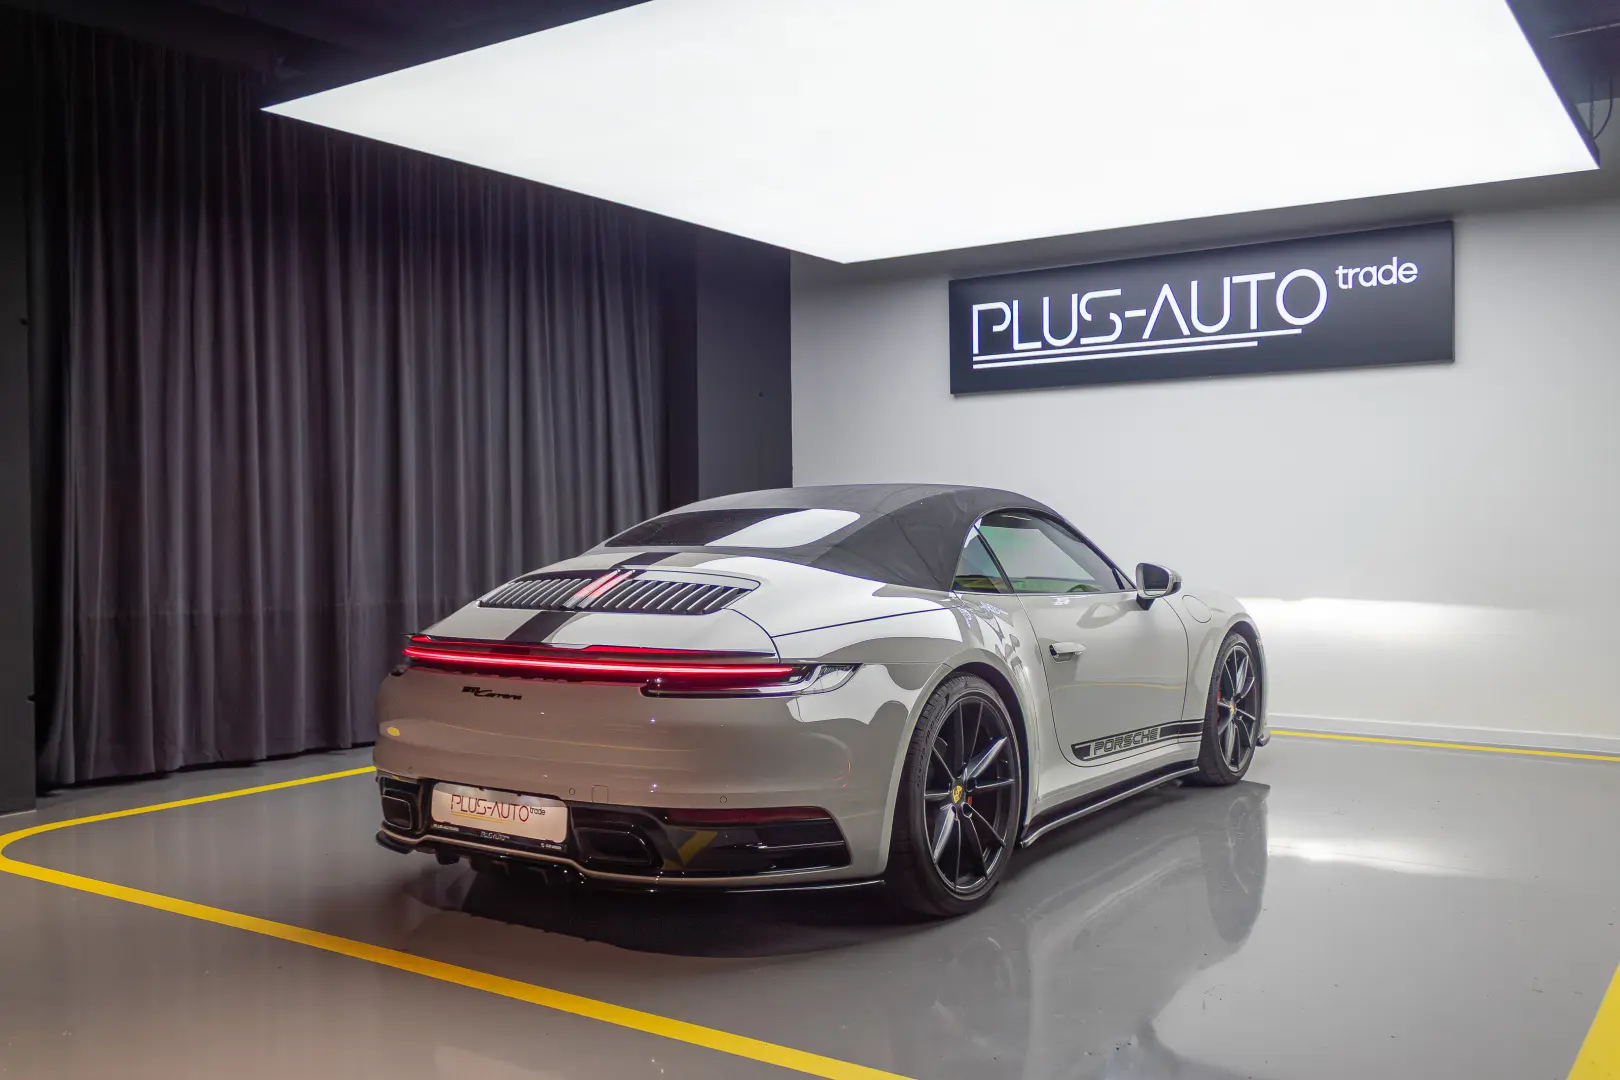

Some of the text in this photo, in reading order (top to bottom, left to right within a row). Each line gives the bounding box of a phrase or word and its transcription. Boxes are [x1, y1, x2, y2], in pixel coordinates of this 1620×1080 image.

[972, 256, 1419, 354] PLUS-AUTO trade
[1093, 727, 1159, 755] PORSCHE
[450, 794, 546, 822] PLUS-AUTO trade
